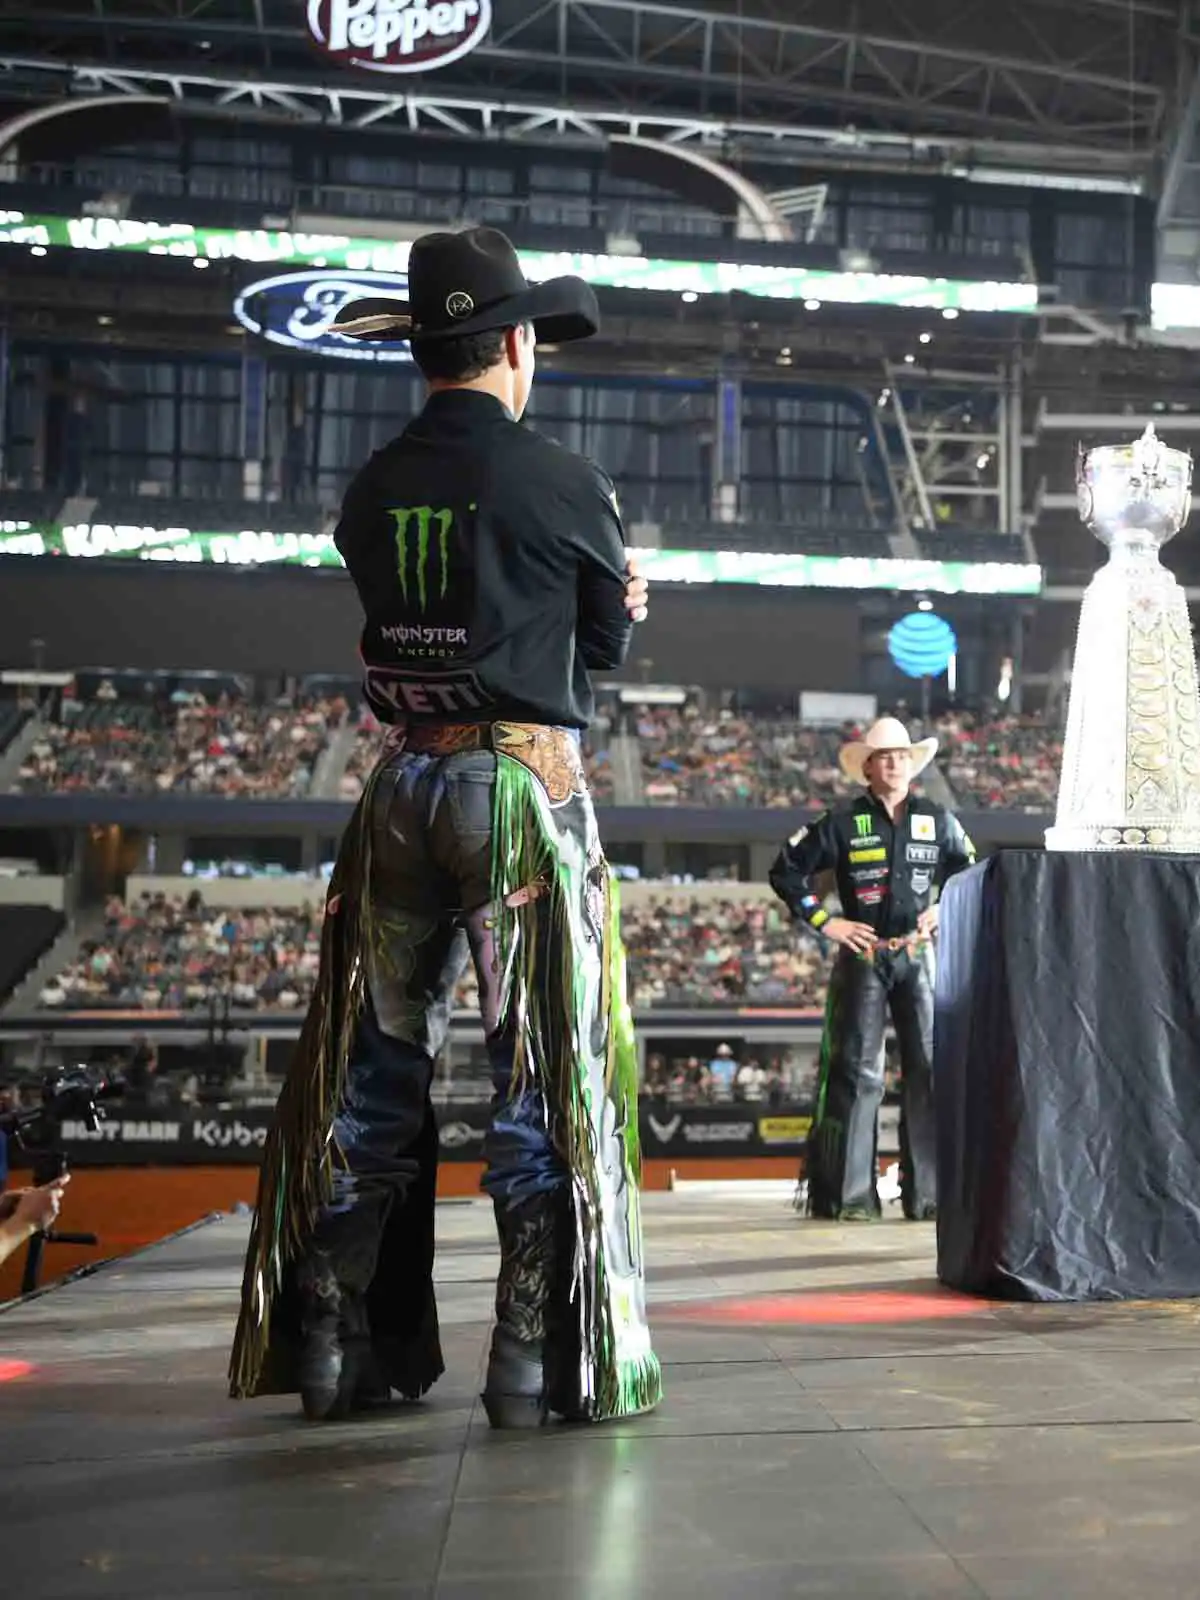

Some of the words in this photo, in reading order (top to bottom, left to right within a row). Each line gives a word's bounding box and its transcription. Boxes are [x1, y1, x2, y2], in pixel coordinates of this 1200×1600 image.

[380, 622, 467, 645] MONSTER
[371, 678, 481, 713] YETI
[122, 1120, 180, 1142] BARN
[193, 1119, 268, 1148] Kubo
